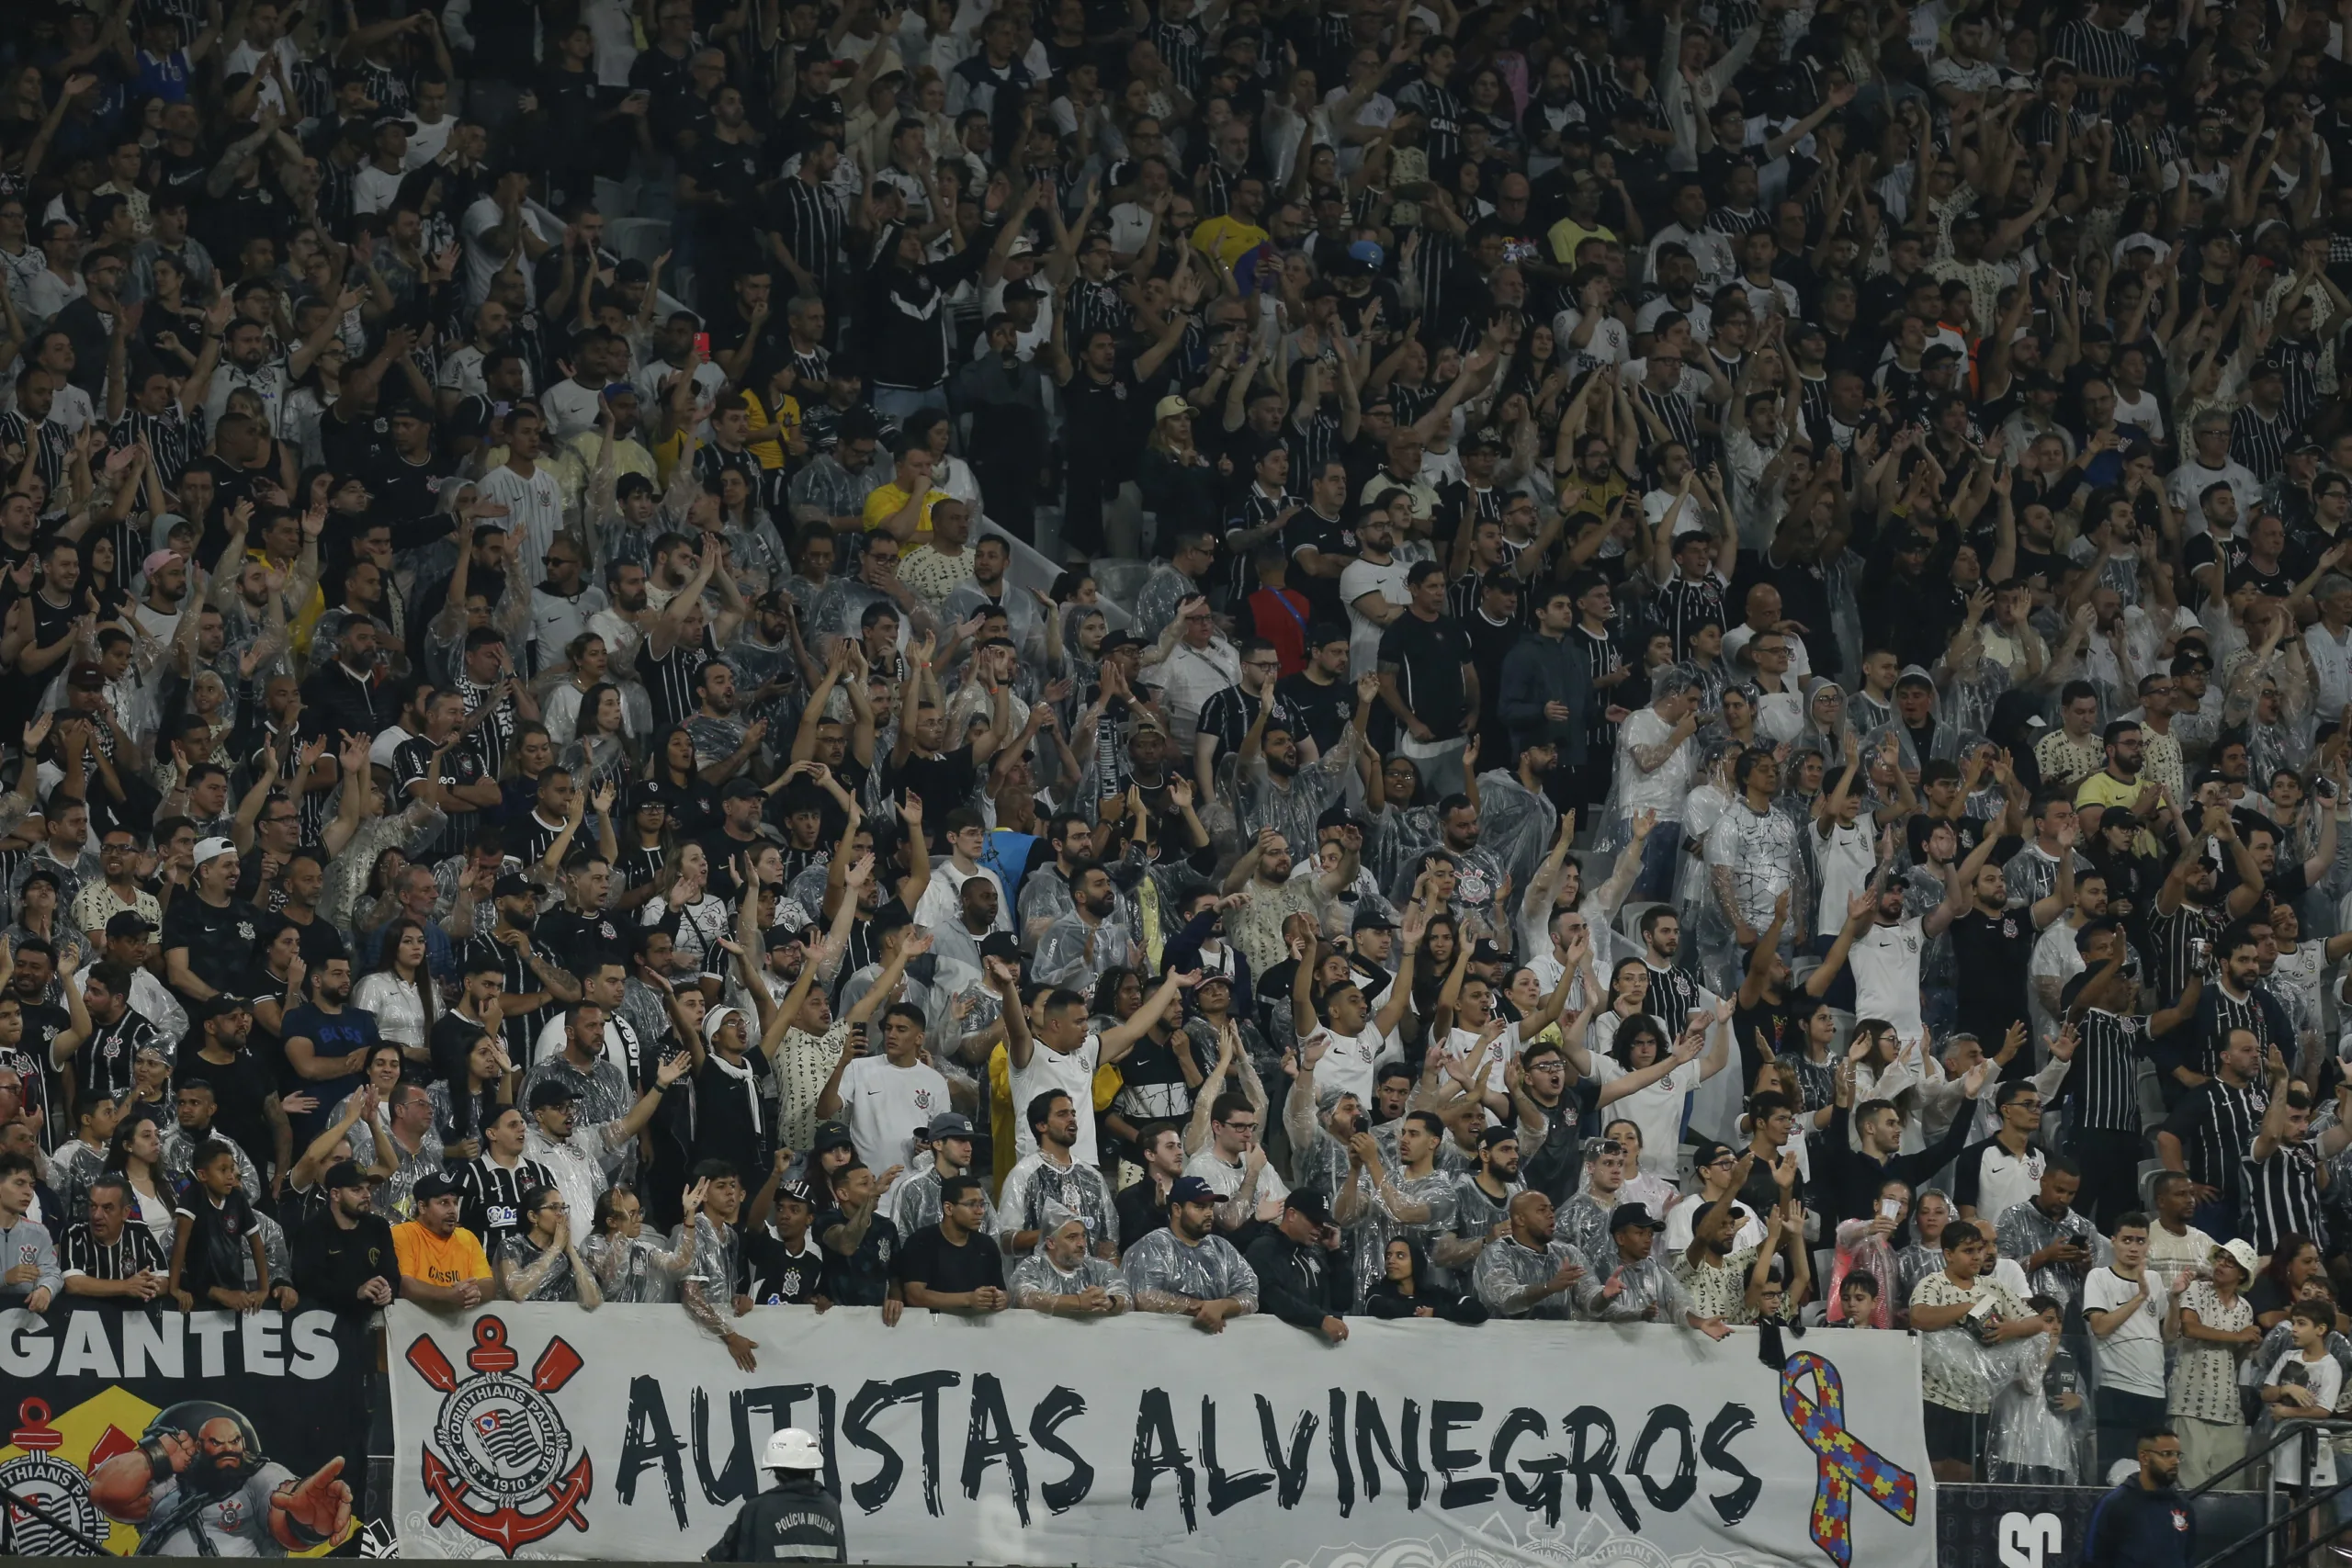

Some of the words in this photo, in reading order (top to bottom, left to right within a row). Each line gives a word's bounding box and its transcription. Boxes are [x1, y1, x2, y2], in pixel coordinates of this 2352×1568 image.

[451, 1385, 526, 1444] CORINTHIANS
[527, 1400, 557, 1473] PAULISTA
[458, 1444, 481, 1475] S.C.
[616, 1370, 1095, 1532] AUTISTAS
[1130, 1387, 1762, 1535] ALVINEGROS
[492, 1478, 526, 1492] 1910
[775, 1512, 806, 1535] POLÍCIA
[807, 1512, 836, 1537] MILITAR
